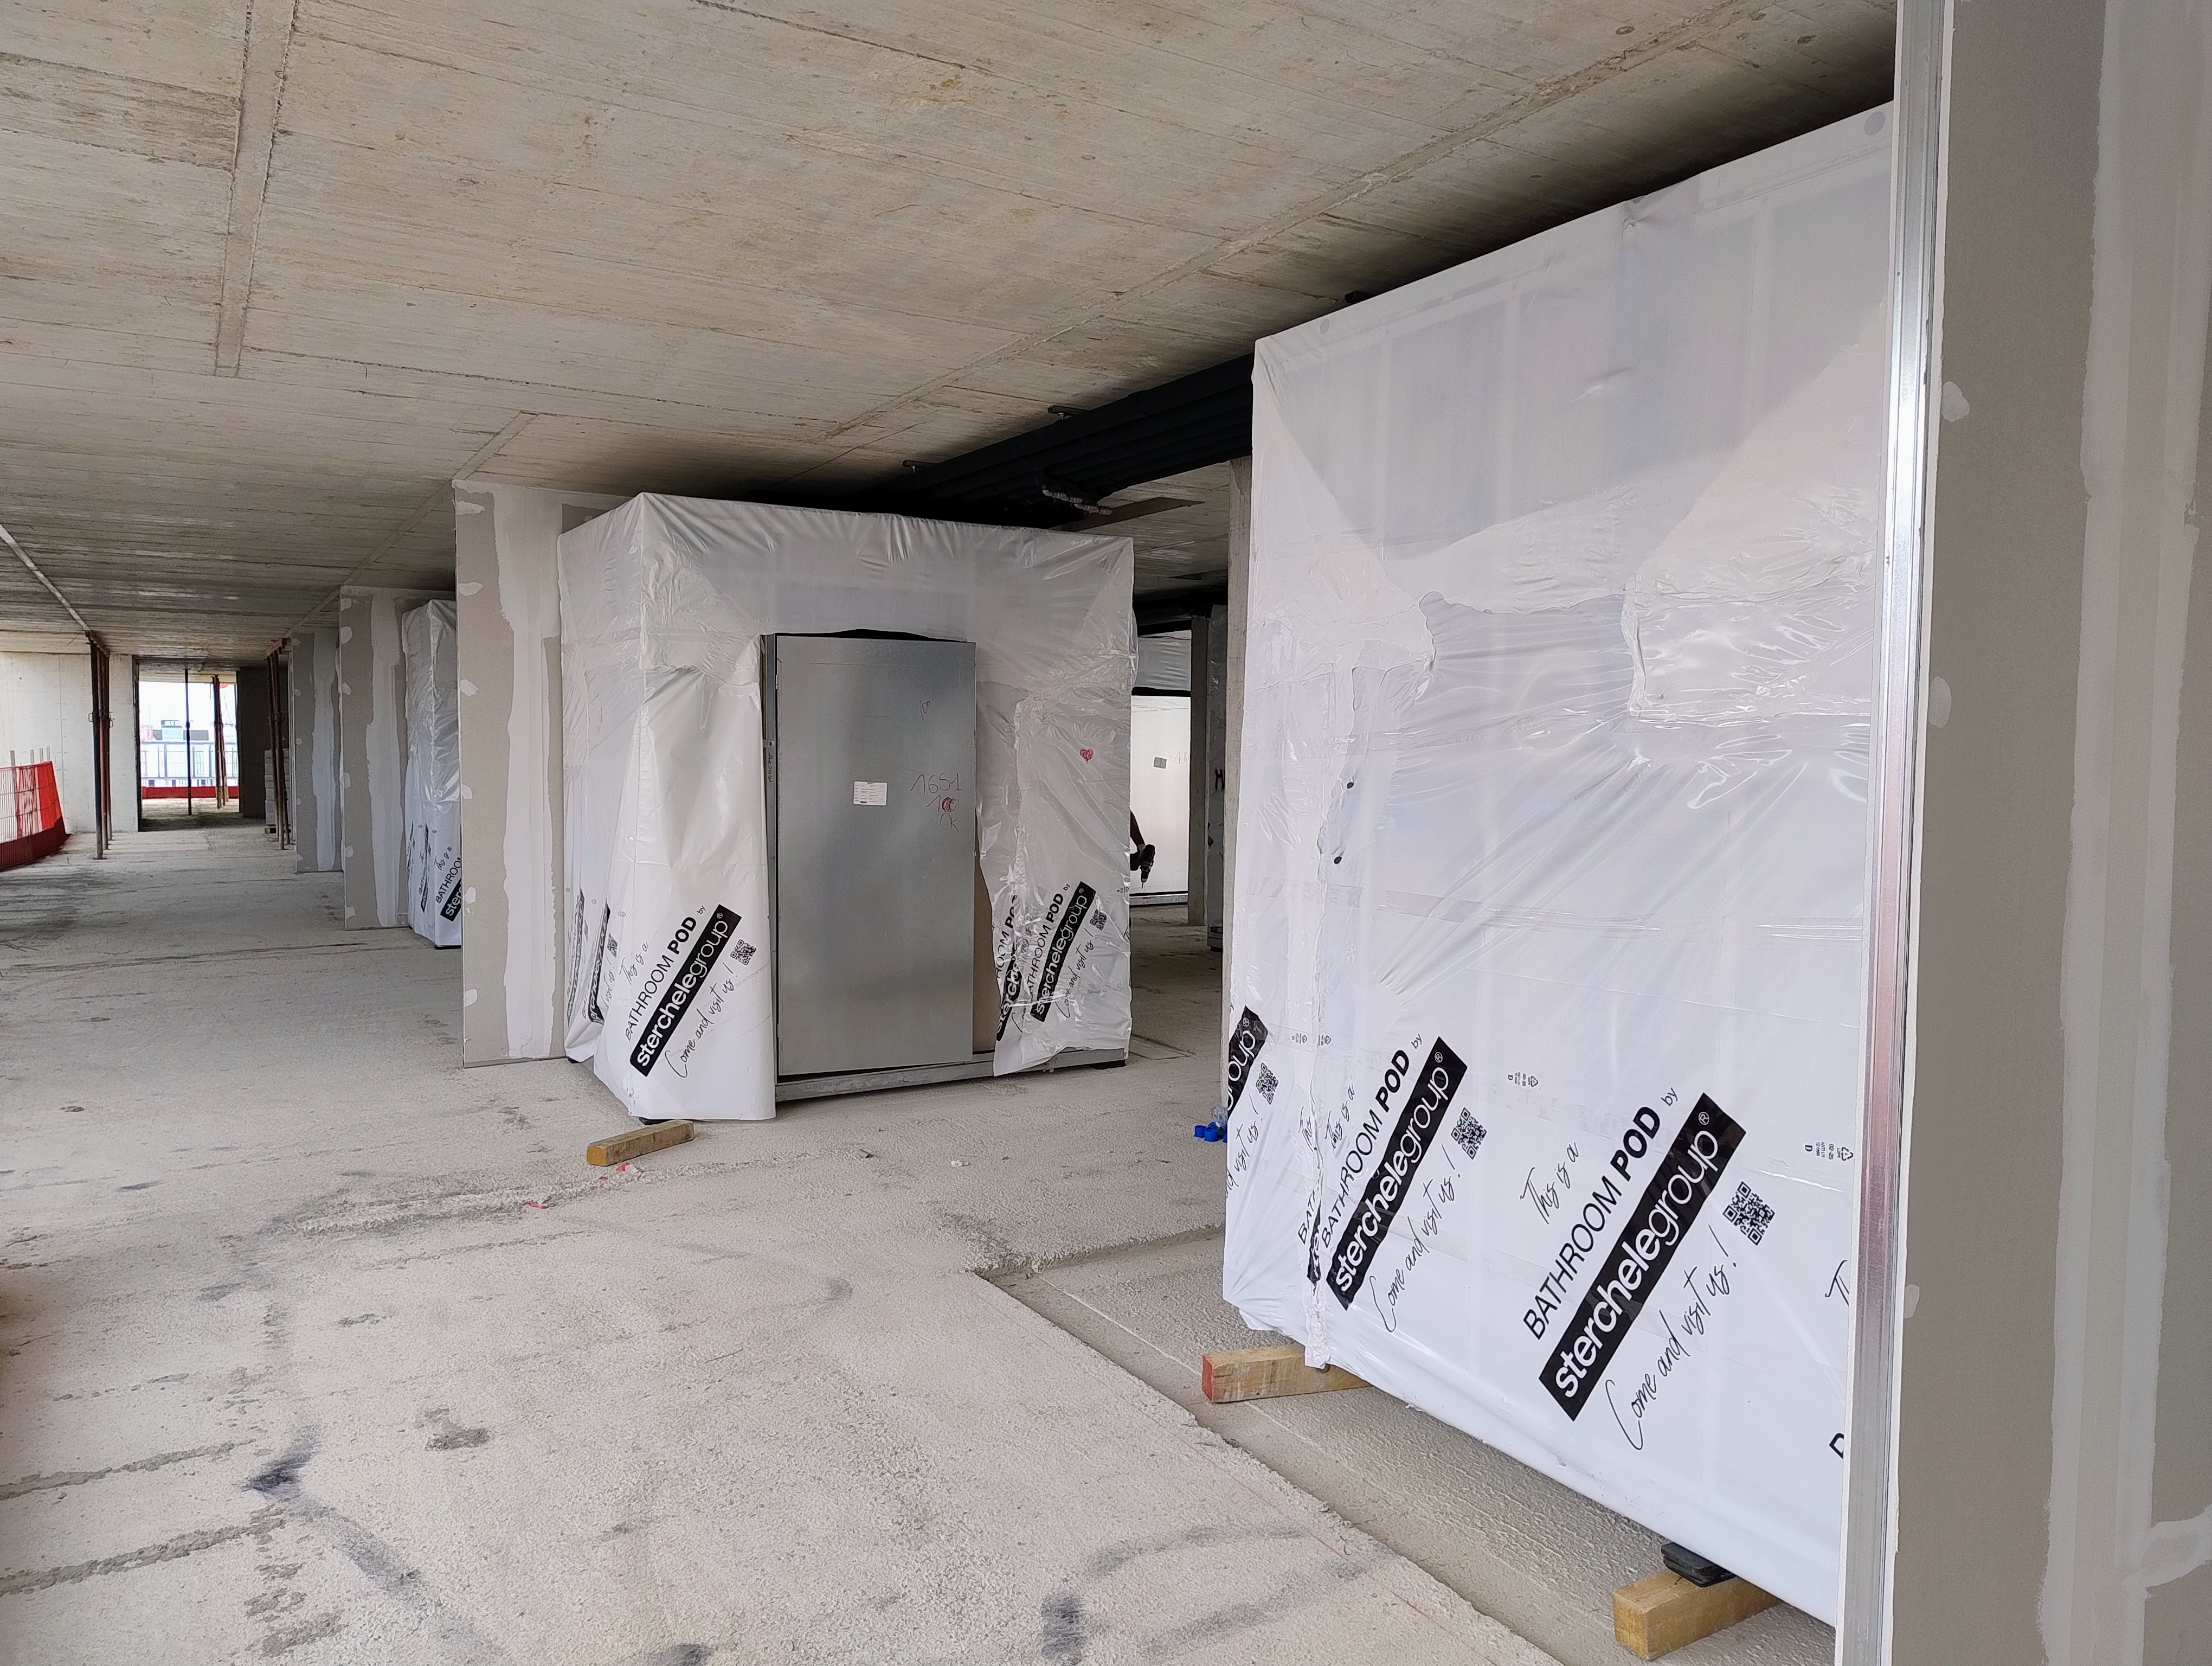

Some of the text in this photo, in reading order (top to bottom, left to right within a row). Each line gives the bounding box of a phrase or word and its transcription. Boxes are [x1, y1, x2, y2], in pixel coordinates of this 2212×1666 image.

[909, 772, 963, 794] 1651
[1046, 893, 1064, 923] POD
[1062, 883, 1071, 891] by
[619, 941, 650, 985] This is a
[625, 905, 706, 1041] BATHROOM POD by
[1068, 965, 1081, 988] and
[1075, 944, 1087, 971] visit
[665, 1039, 696, 1079] Come
[696, 1007, 714, 1039] and
[708, 982, 725, 1015] visit
[1347, 1082, 1356, 1101] a
[1233, 1123, 1250, 1172] visit
[1322, 1033, 1424, 1249] BATHROOM POD by
[1804, 1144, 1813, 1152] D
[1519, 1142, 1580, 1225] This is a
[1523, 1087, 1679, 1340] BATHROOM POD by
[1369, 1268, 1407, 1333] Come
[1405, 1216, 1432, 1271] and
[1420, 1178, 1443, 1235] visit
[1604, 1372, 1657, 1451] Come
[1657, 1309, 1692, 1379] and
[1680, 1266, 1712, 1337] visit
